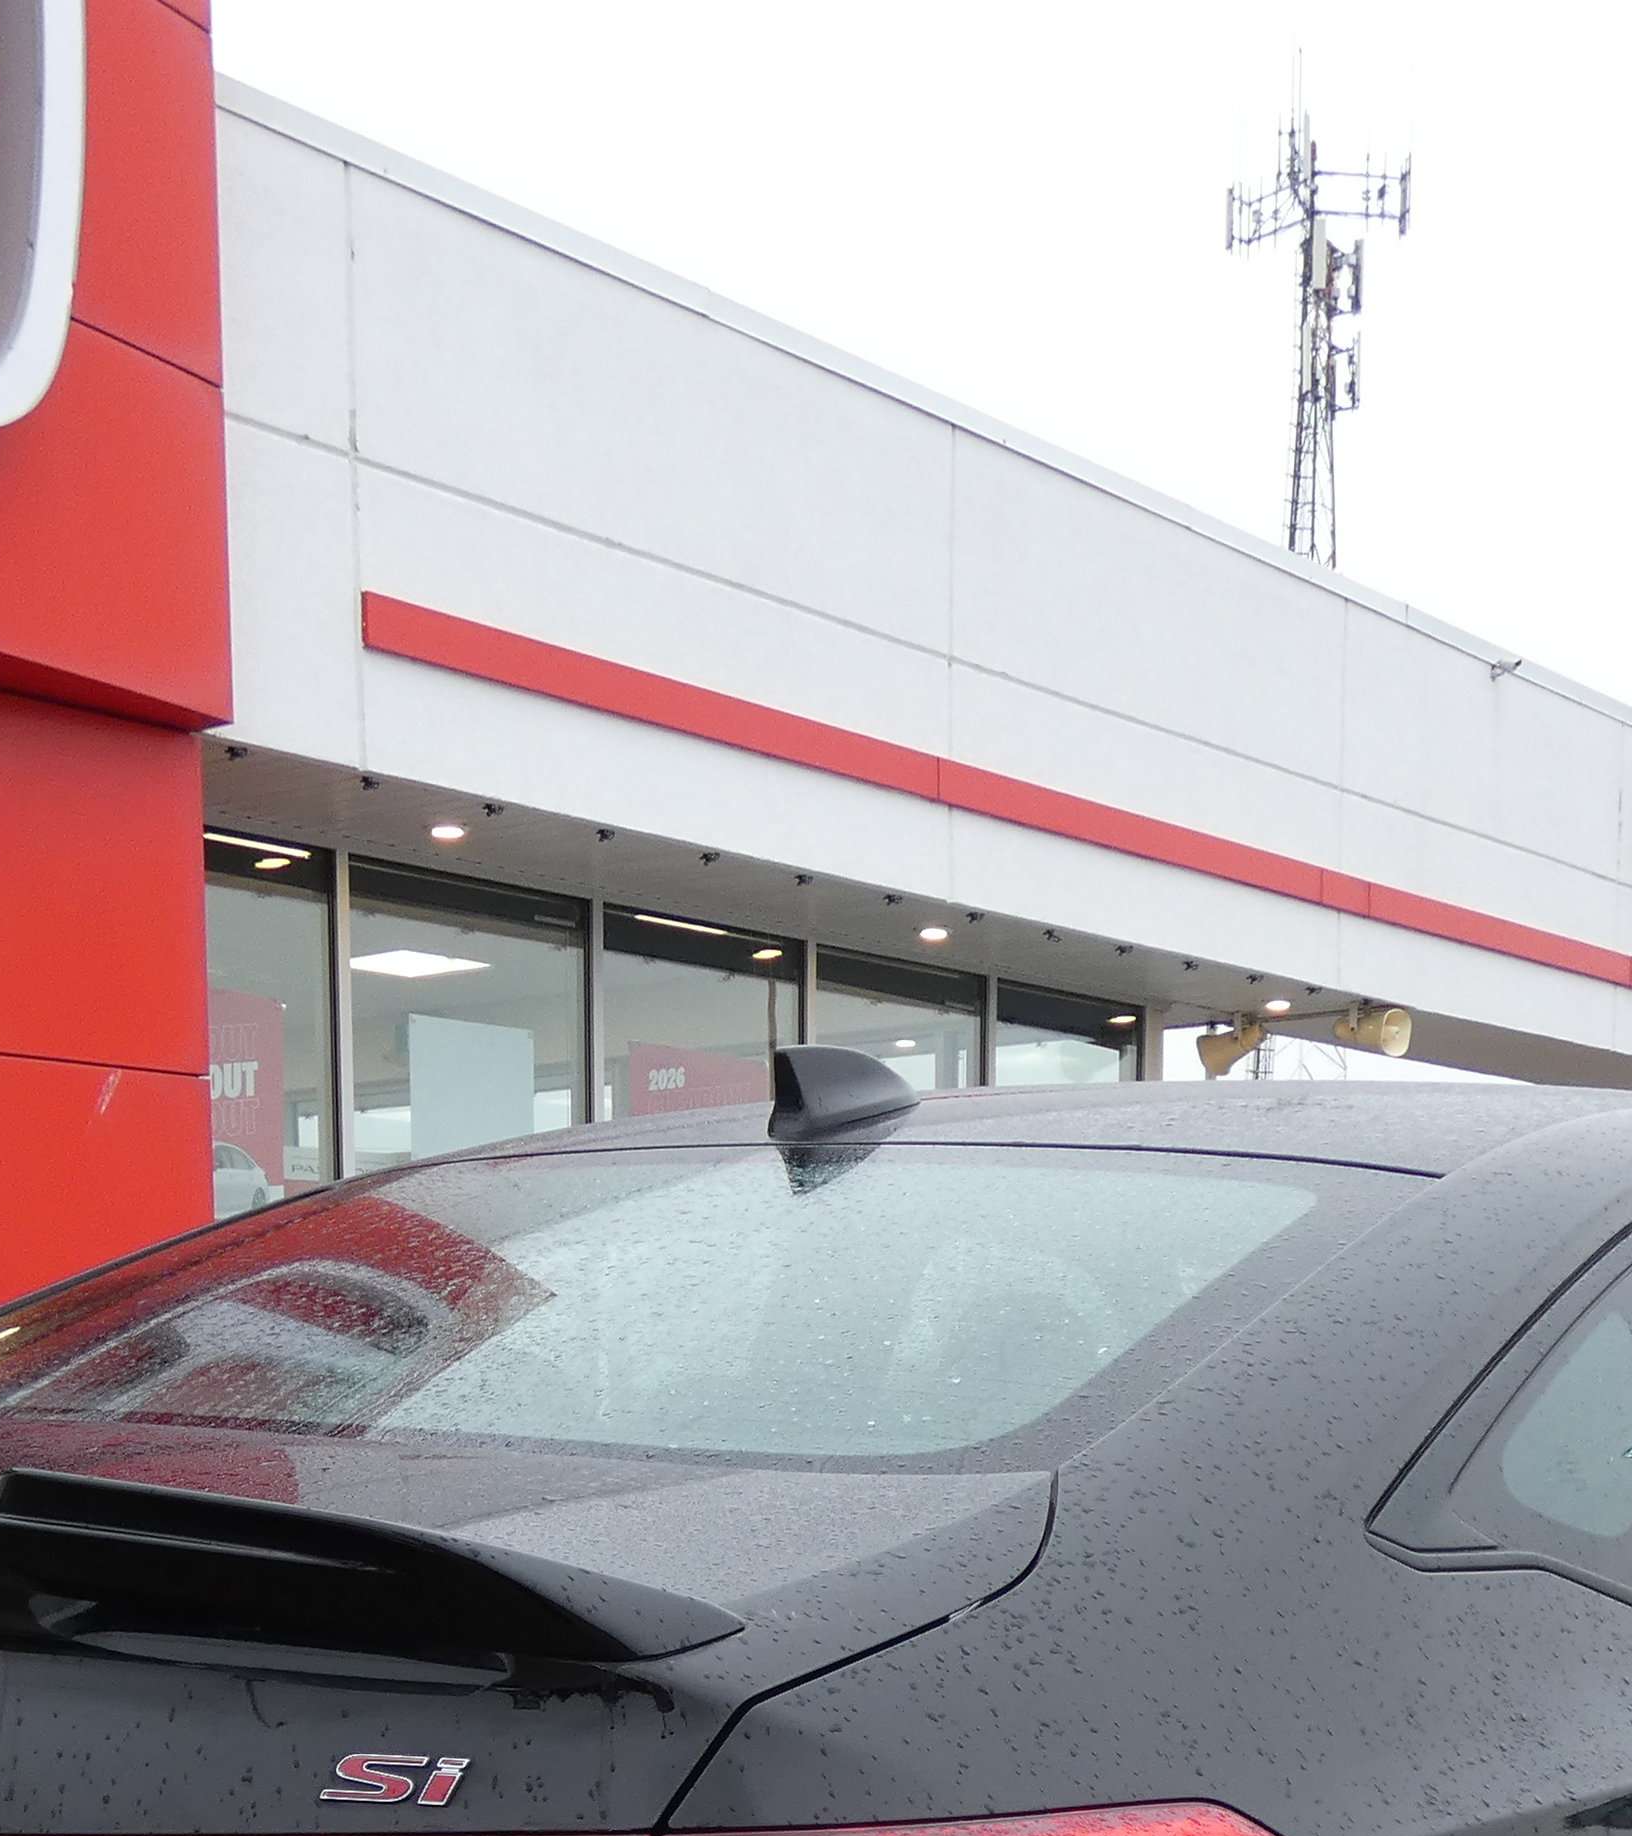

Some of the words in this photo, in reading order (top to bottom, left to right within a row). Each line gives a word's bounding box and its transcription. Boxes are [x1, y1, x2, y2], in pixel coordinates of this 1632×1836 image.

[210, 1061, 258, 1099] OUT
[648, 1066, 686, 1092] 2026
[320, 1753, 470, 1806] Si
